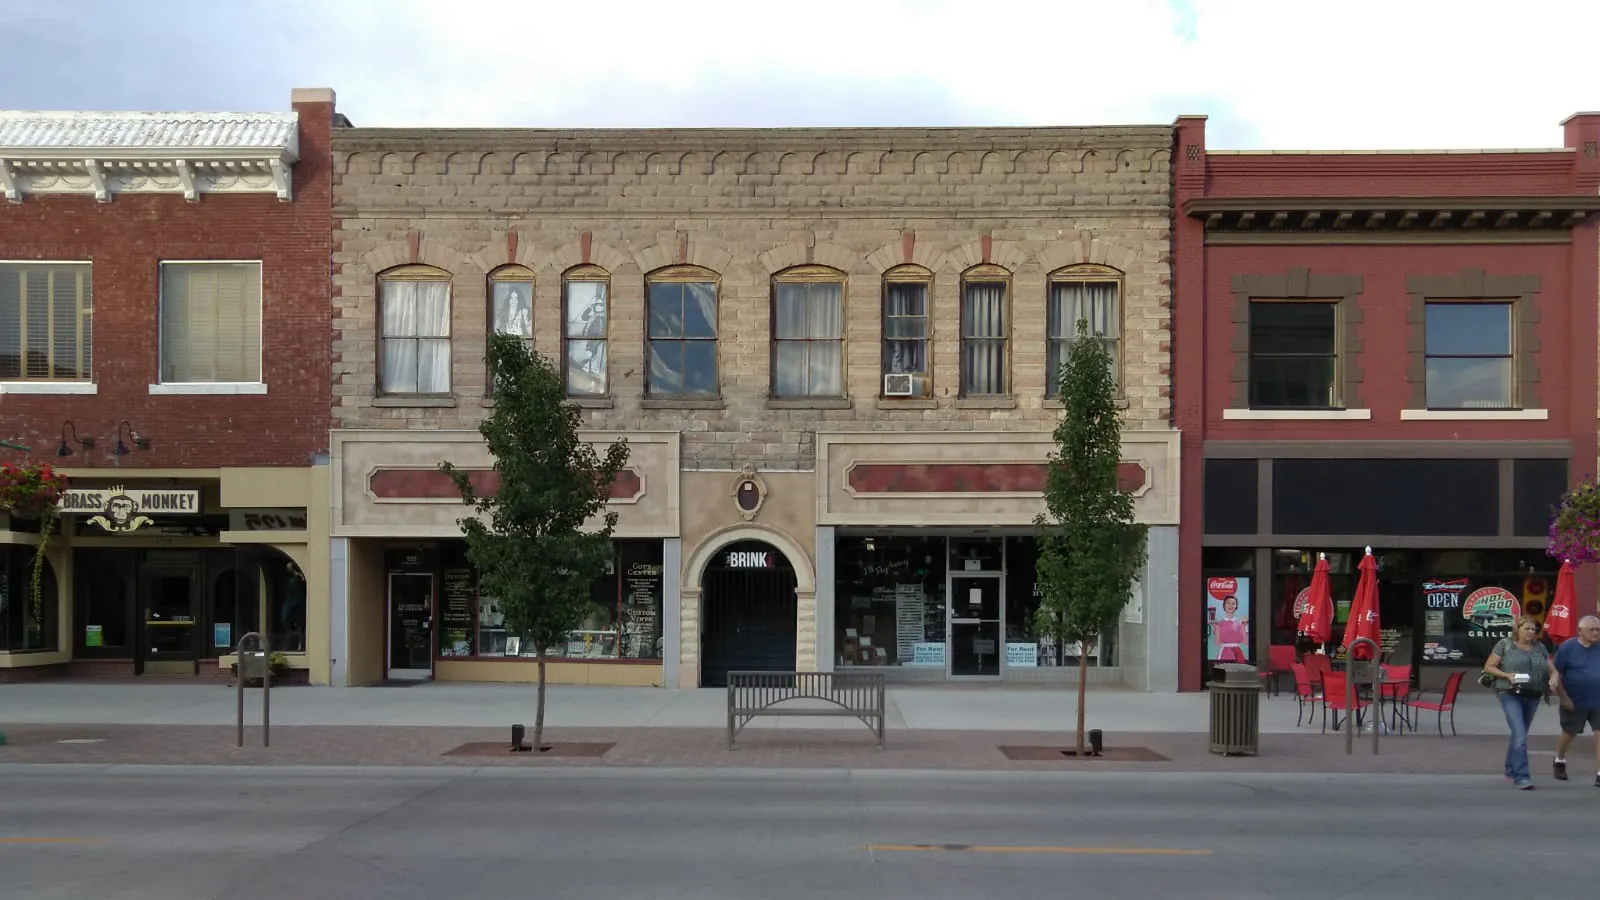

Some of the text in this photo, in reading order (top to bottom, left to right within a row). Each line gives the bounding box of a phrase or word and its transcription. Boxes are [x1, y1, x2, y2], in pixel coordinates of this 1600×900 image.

[64, 493, 195, 509] BRASS MONKEY
[730, 551, 768, 568] BRINK
[1427, 592, 1459, 608] OPEN
[1481, 593, 1504, 605] HOT
[1489, 600, 1513, 611] ROD
